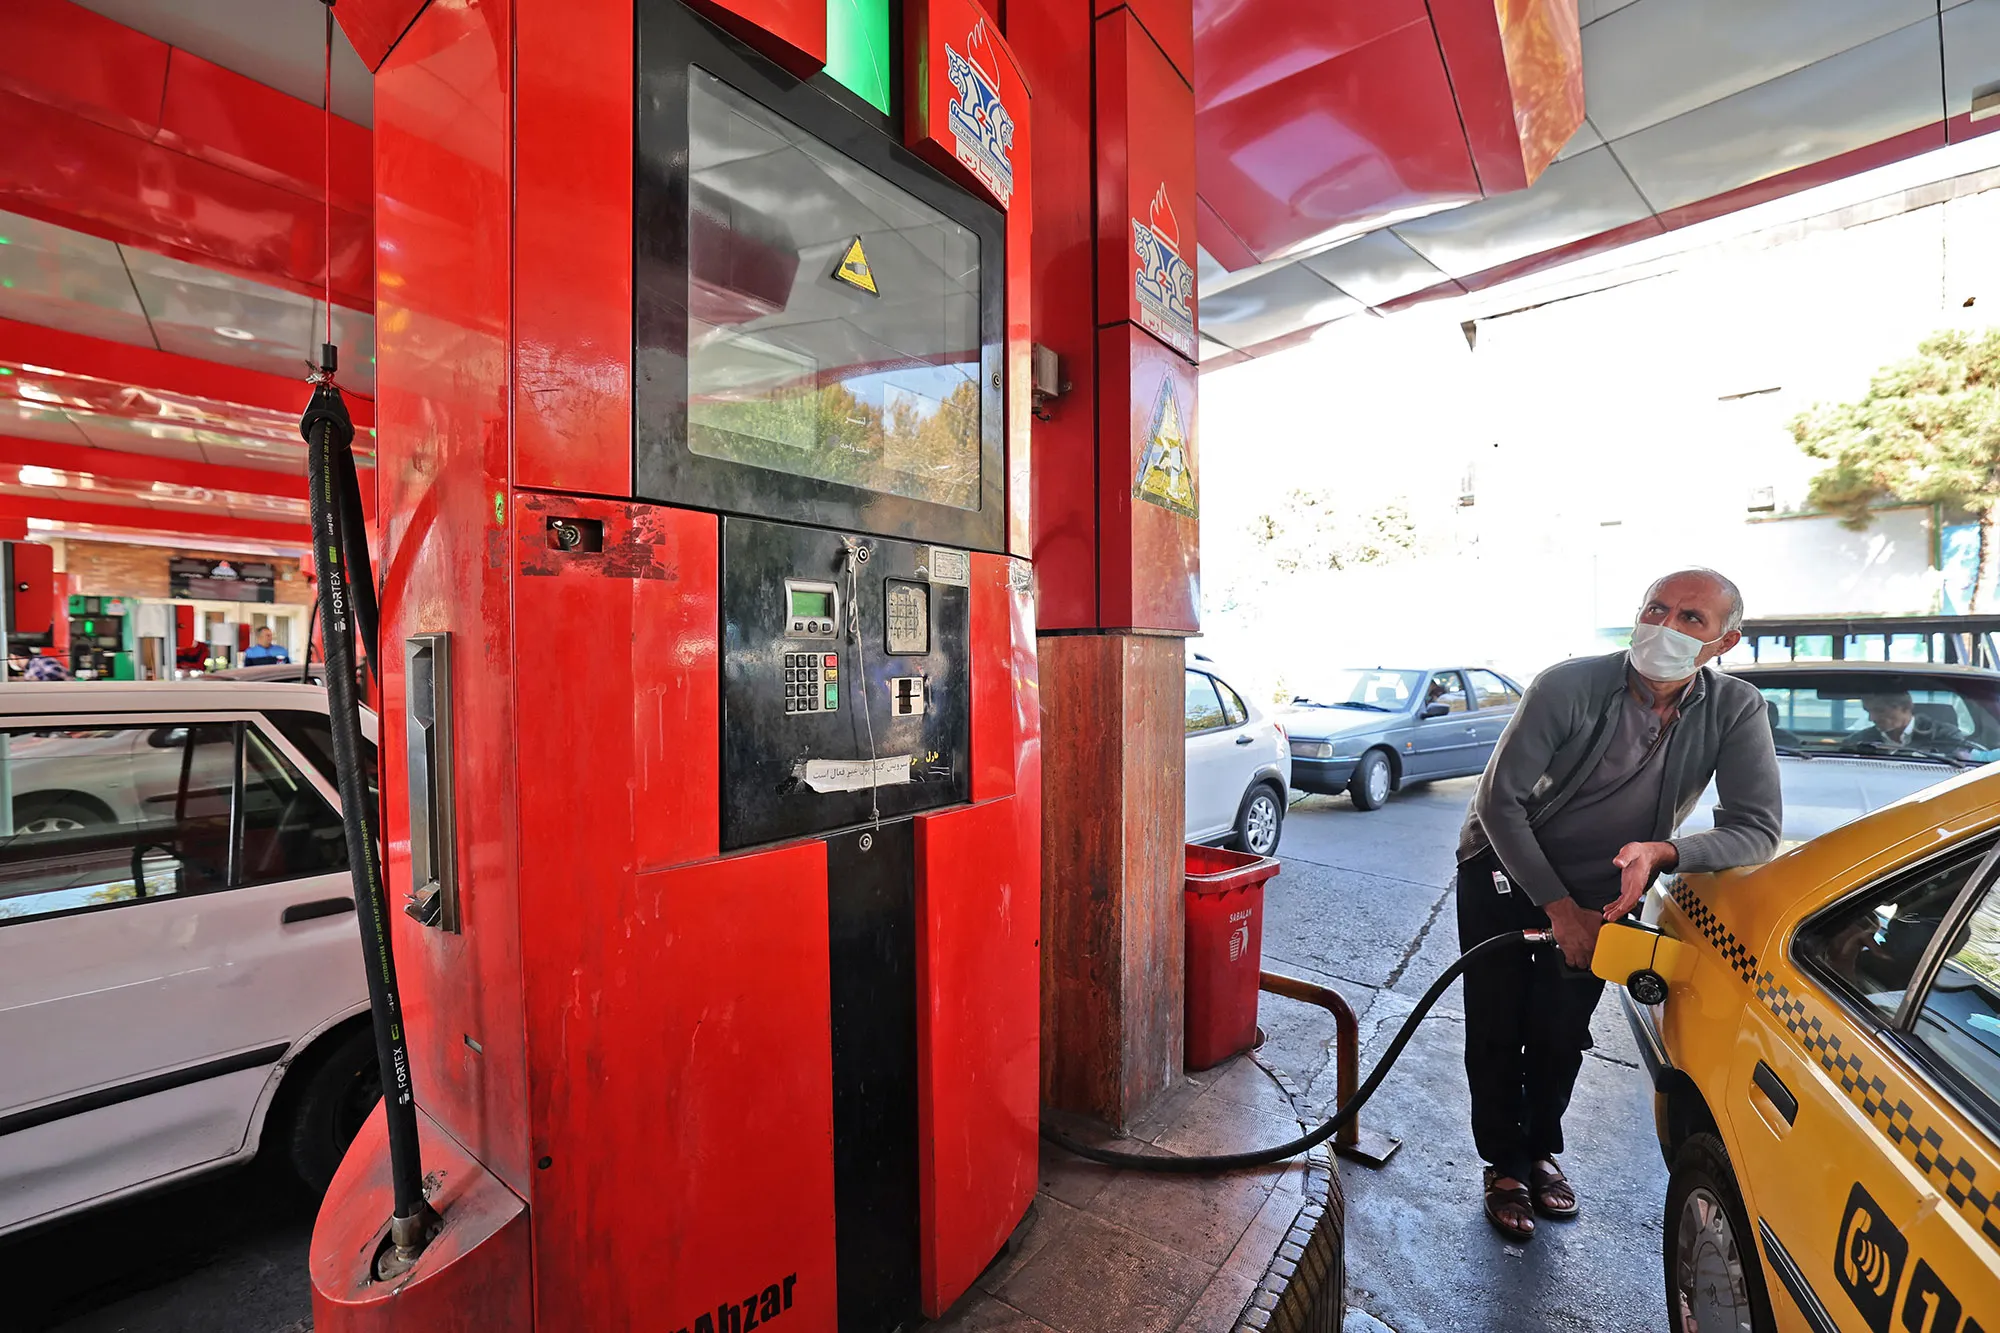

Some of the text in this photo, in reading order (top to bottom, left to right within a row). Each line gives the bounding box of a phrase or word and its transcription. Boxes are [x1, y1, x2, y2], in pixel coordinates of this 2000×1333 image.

[330, 571, 344, 614] FORTEX
[830, 768, 846, 780] فعال
[886, 762, 908, 773] سرویس
[813, 769, 829, 780] است
[1229, 908, 1252, 923] SABALAN
[393, 1046, 408, 1089] FORTEX
